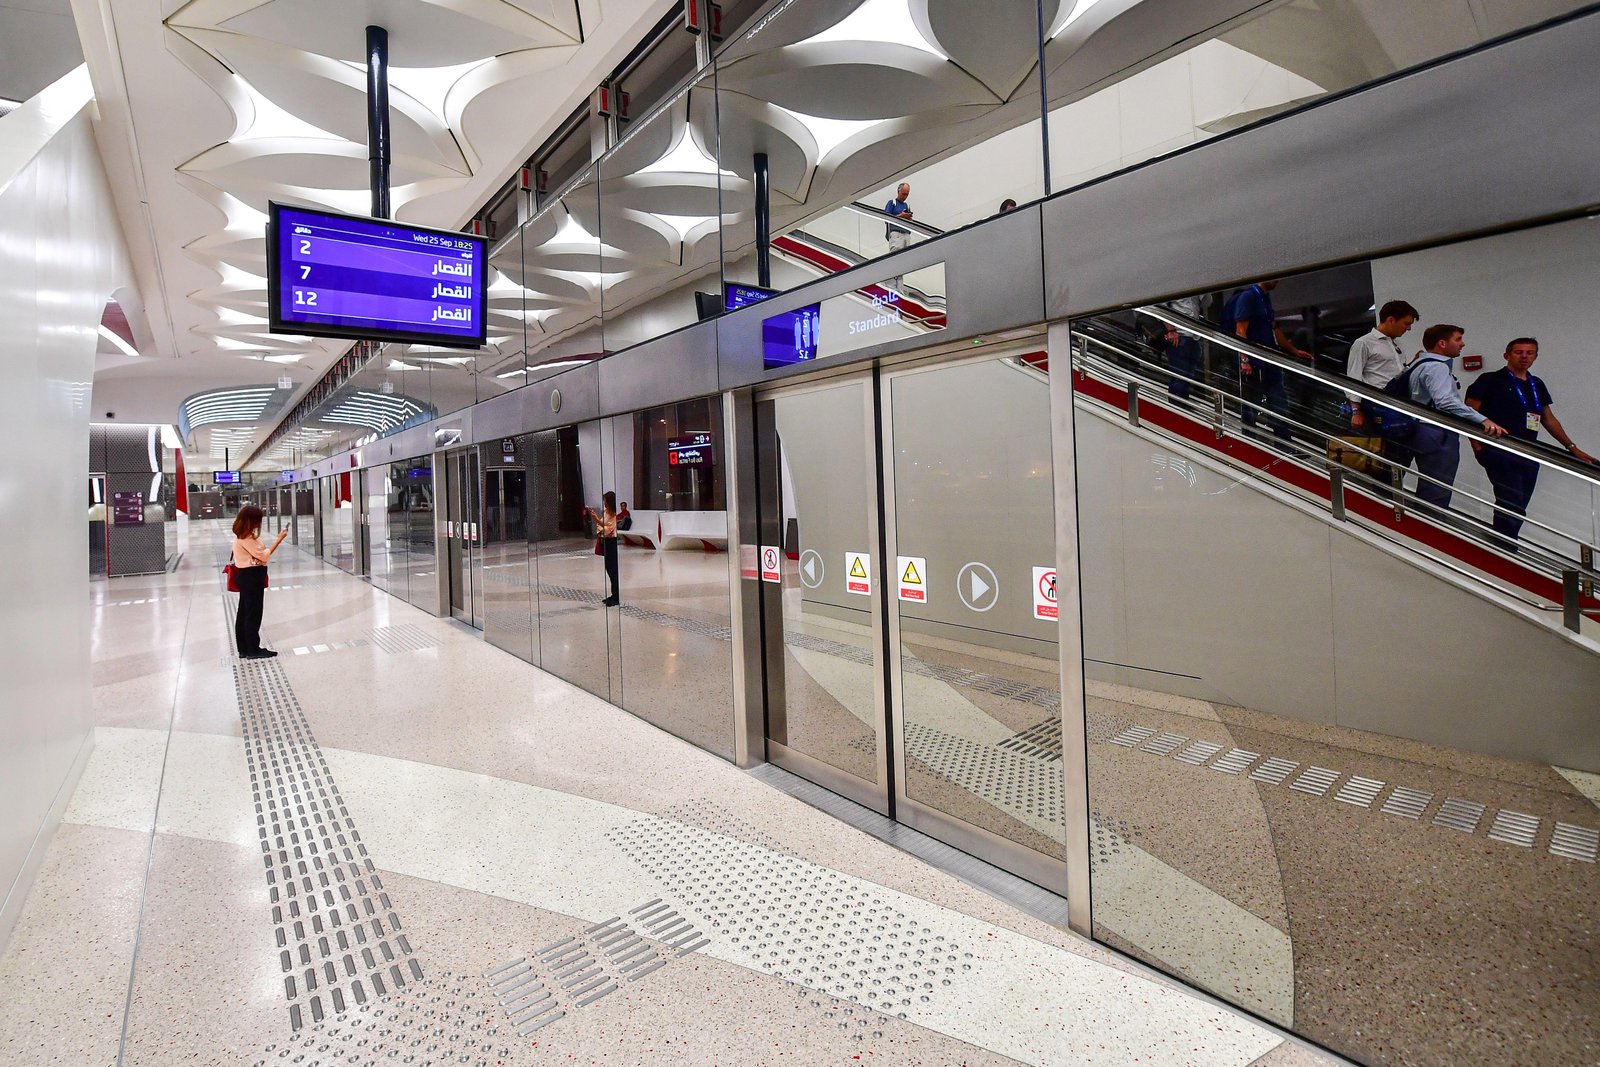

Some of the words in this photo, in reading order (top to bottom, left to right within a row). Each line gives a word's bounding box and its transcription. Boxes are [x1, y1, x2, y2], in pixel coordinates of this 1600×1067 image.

[299, 240, 312, 255] 2
[413, 233, 428, 243] Wed
[429, 236, 439, 245] 25
[440, 238, 452, 247] Sep
[454, 240, 473, 250] 18:25
[299, 265, 312, 280] 7
[431, 259, 473, 277] القصار
[295, 290, 318, 306] 12
[431, 282, 473, 299] القصار
[431, 305, 473, 322] القصار
[848, 308, 901, 335] Standard
